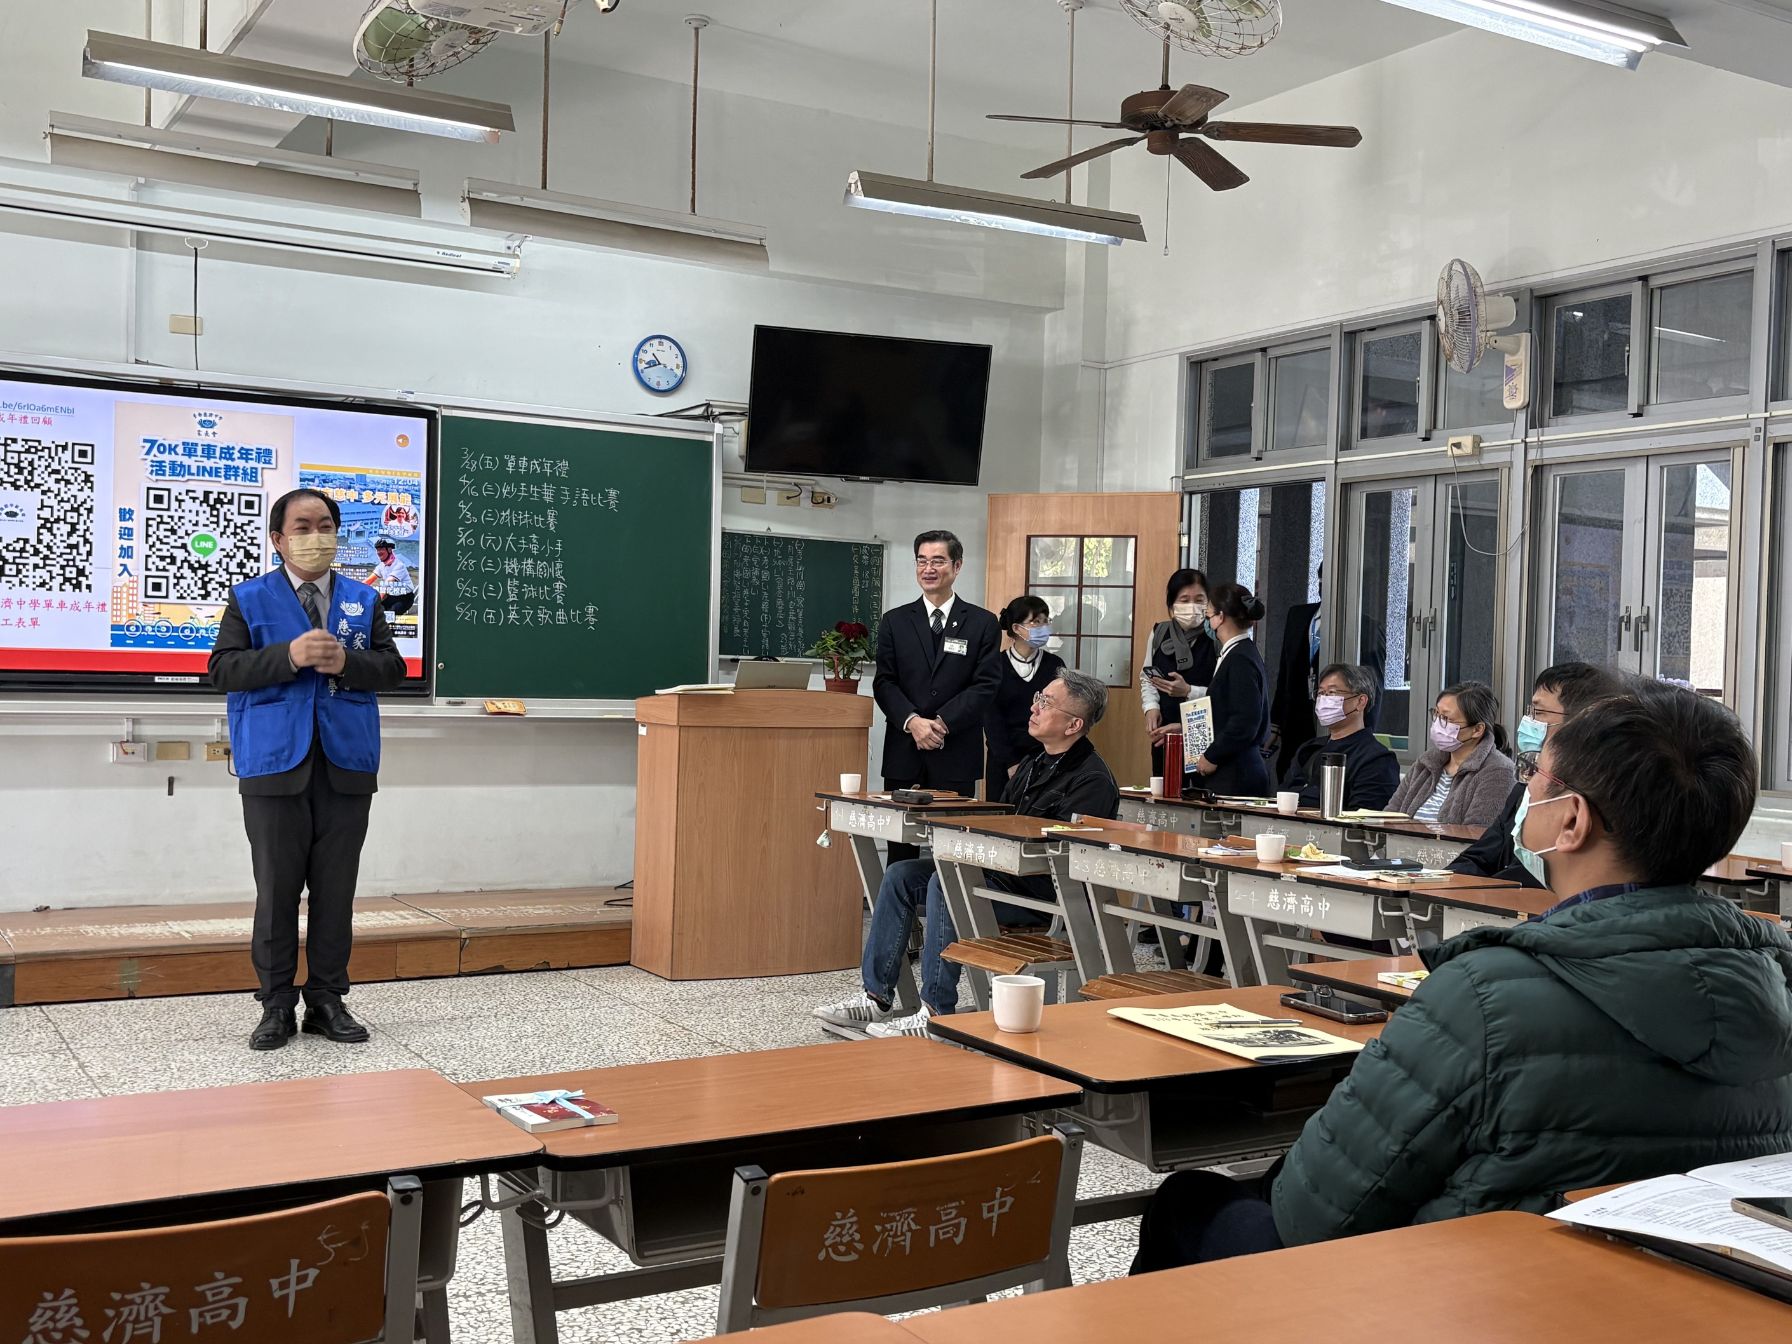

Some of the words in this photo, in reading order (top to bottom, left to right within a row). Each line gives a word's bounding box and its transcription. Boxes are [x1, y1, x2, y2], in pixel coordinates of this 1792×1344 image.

[142, 438, 274, 465] 70K單車成年禮
[149, 460, 259, 483] 活動LINE群組
[504, 454, 570, 478] 單車成年禮
[500, 507, 559, 533] 排球比賽
[118, 507, 134, 577] 歡迎加入
[195, 541, 213, 549] LINE
[505, 533, 565, 558] 大手牽小手
[1, 617, 40, 629] 工表單
[849, 810, 885, 832] 慈濟高中
[953, 840, 998, 865] 慈濟高中
[1267, 889, 1331, 919] 慈濟高中
[817, 1187, 1015, 1262] 慈濟高中
[22, 1258, 321, 1344] 慈濟高中
